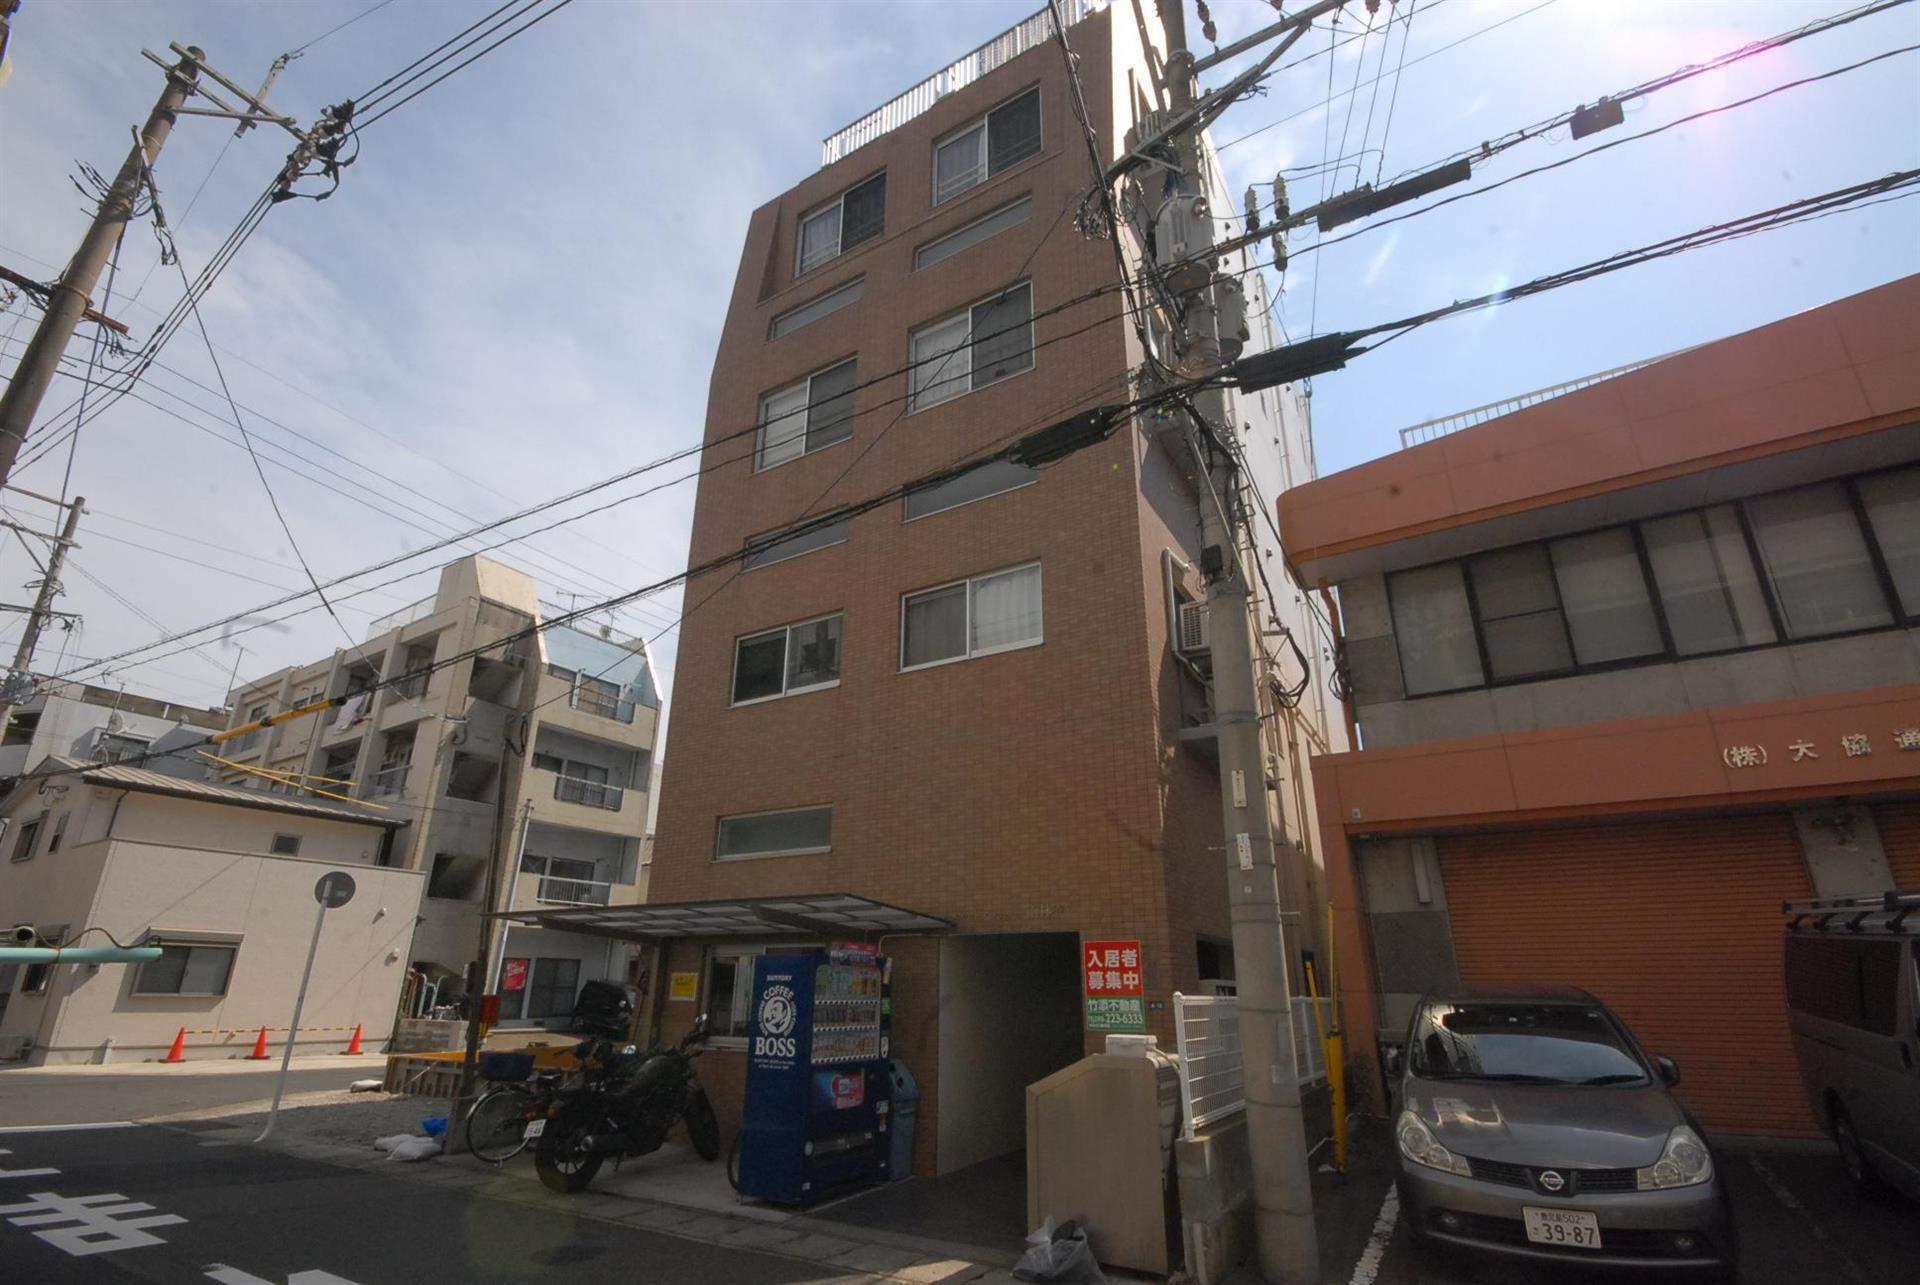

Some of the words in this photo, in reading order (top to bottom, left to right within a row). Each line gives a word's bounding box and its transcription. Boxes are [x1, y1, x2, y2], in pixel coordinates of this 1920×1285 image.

[1087, 948, 1138, 968] 入居者
[1087, 970, 1139, 990] 募集中
[763, 985, 795, 1000] COFFEE
[755, 1037, 796, 1057] BOSS
[1541, 1223, 1595, 1245] 39-87
